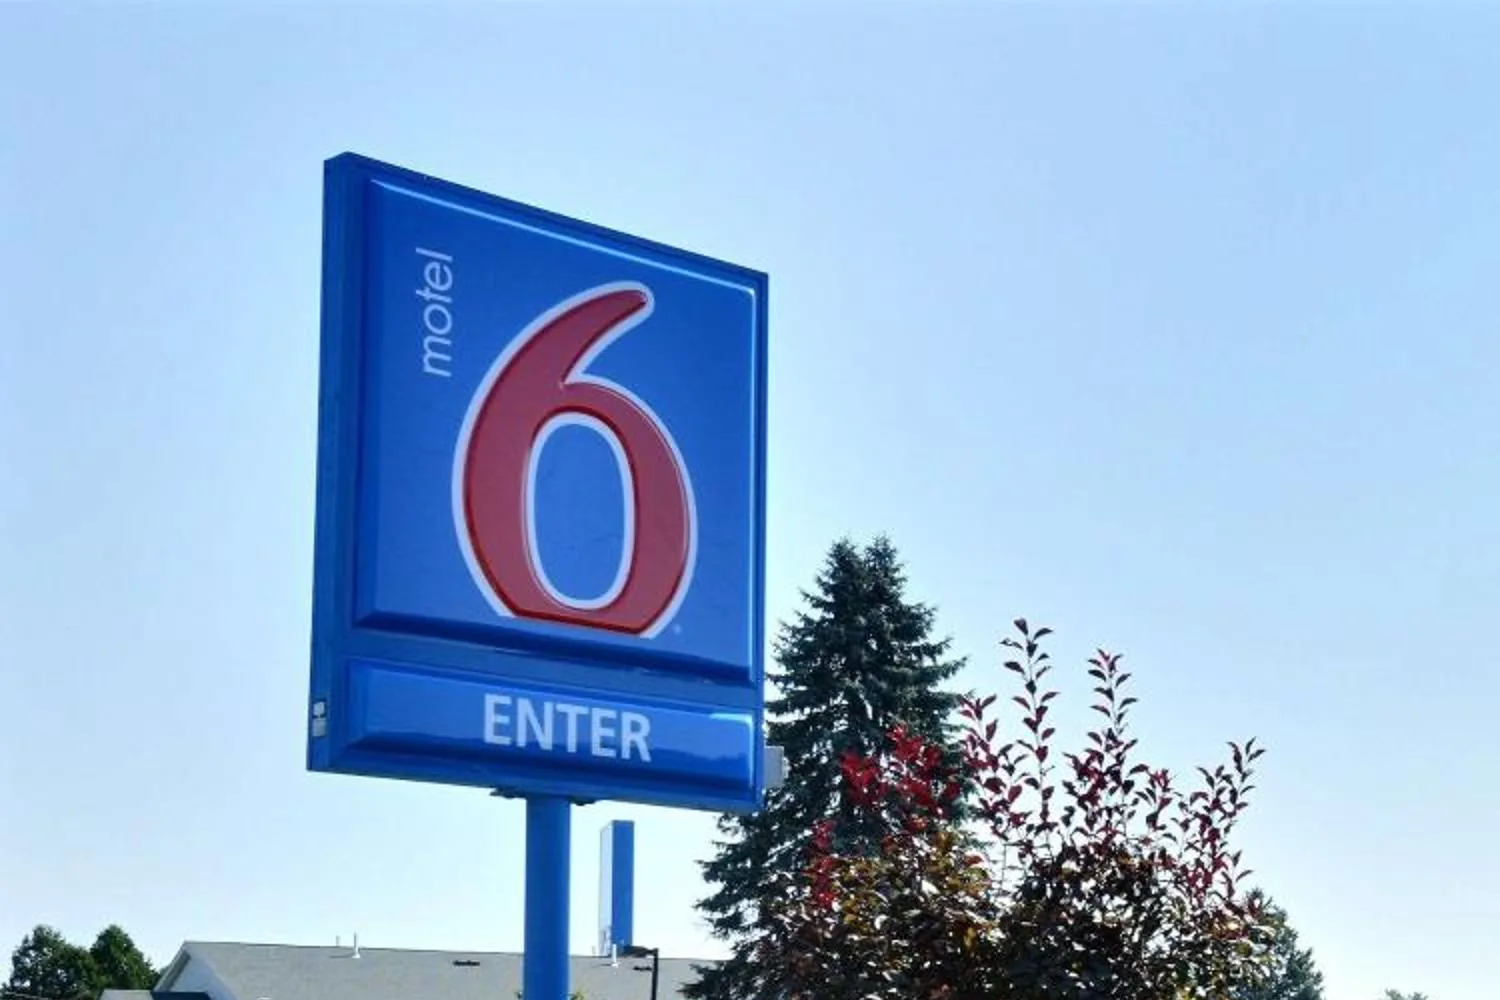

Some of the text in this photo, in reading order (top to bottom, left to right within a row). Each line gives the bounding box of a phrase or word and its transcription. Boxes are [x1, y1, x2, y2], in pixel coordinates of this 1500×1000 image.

[415, 247, 453, 377] motel
[452, 280, 697, 639] 6
[484, 693, 652, 763] ENTER
